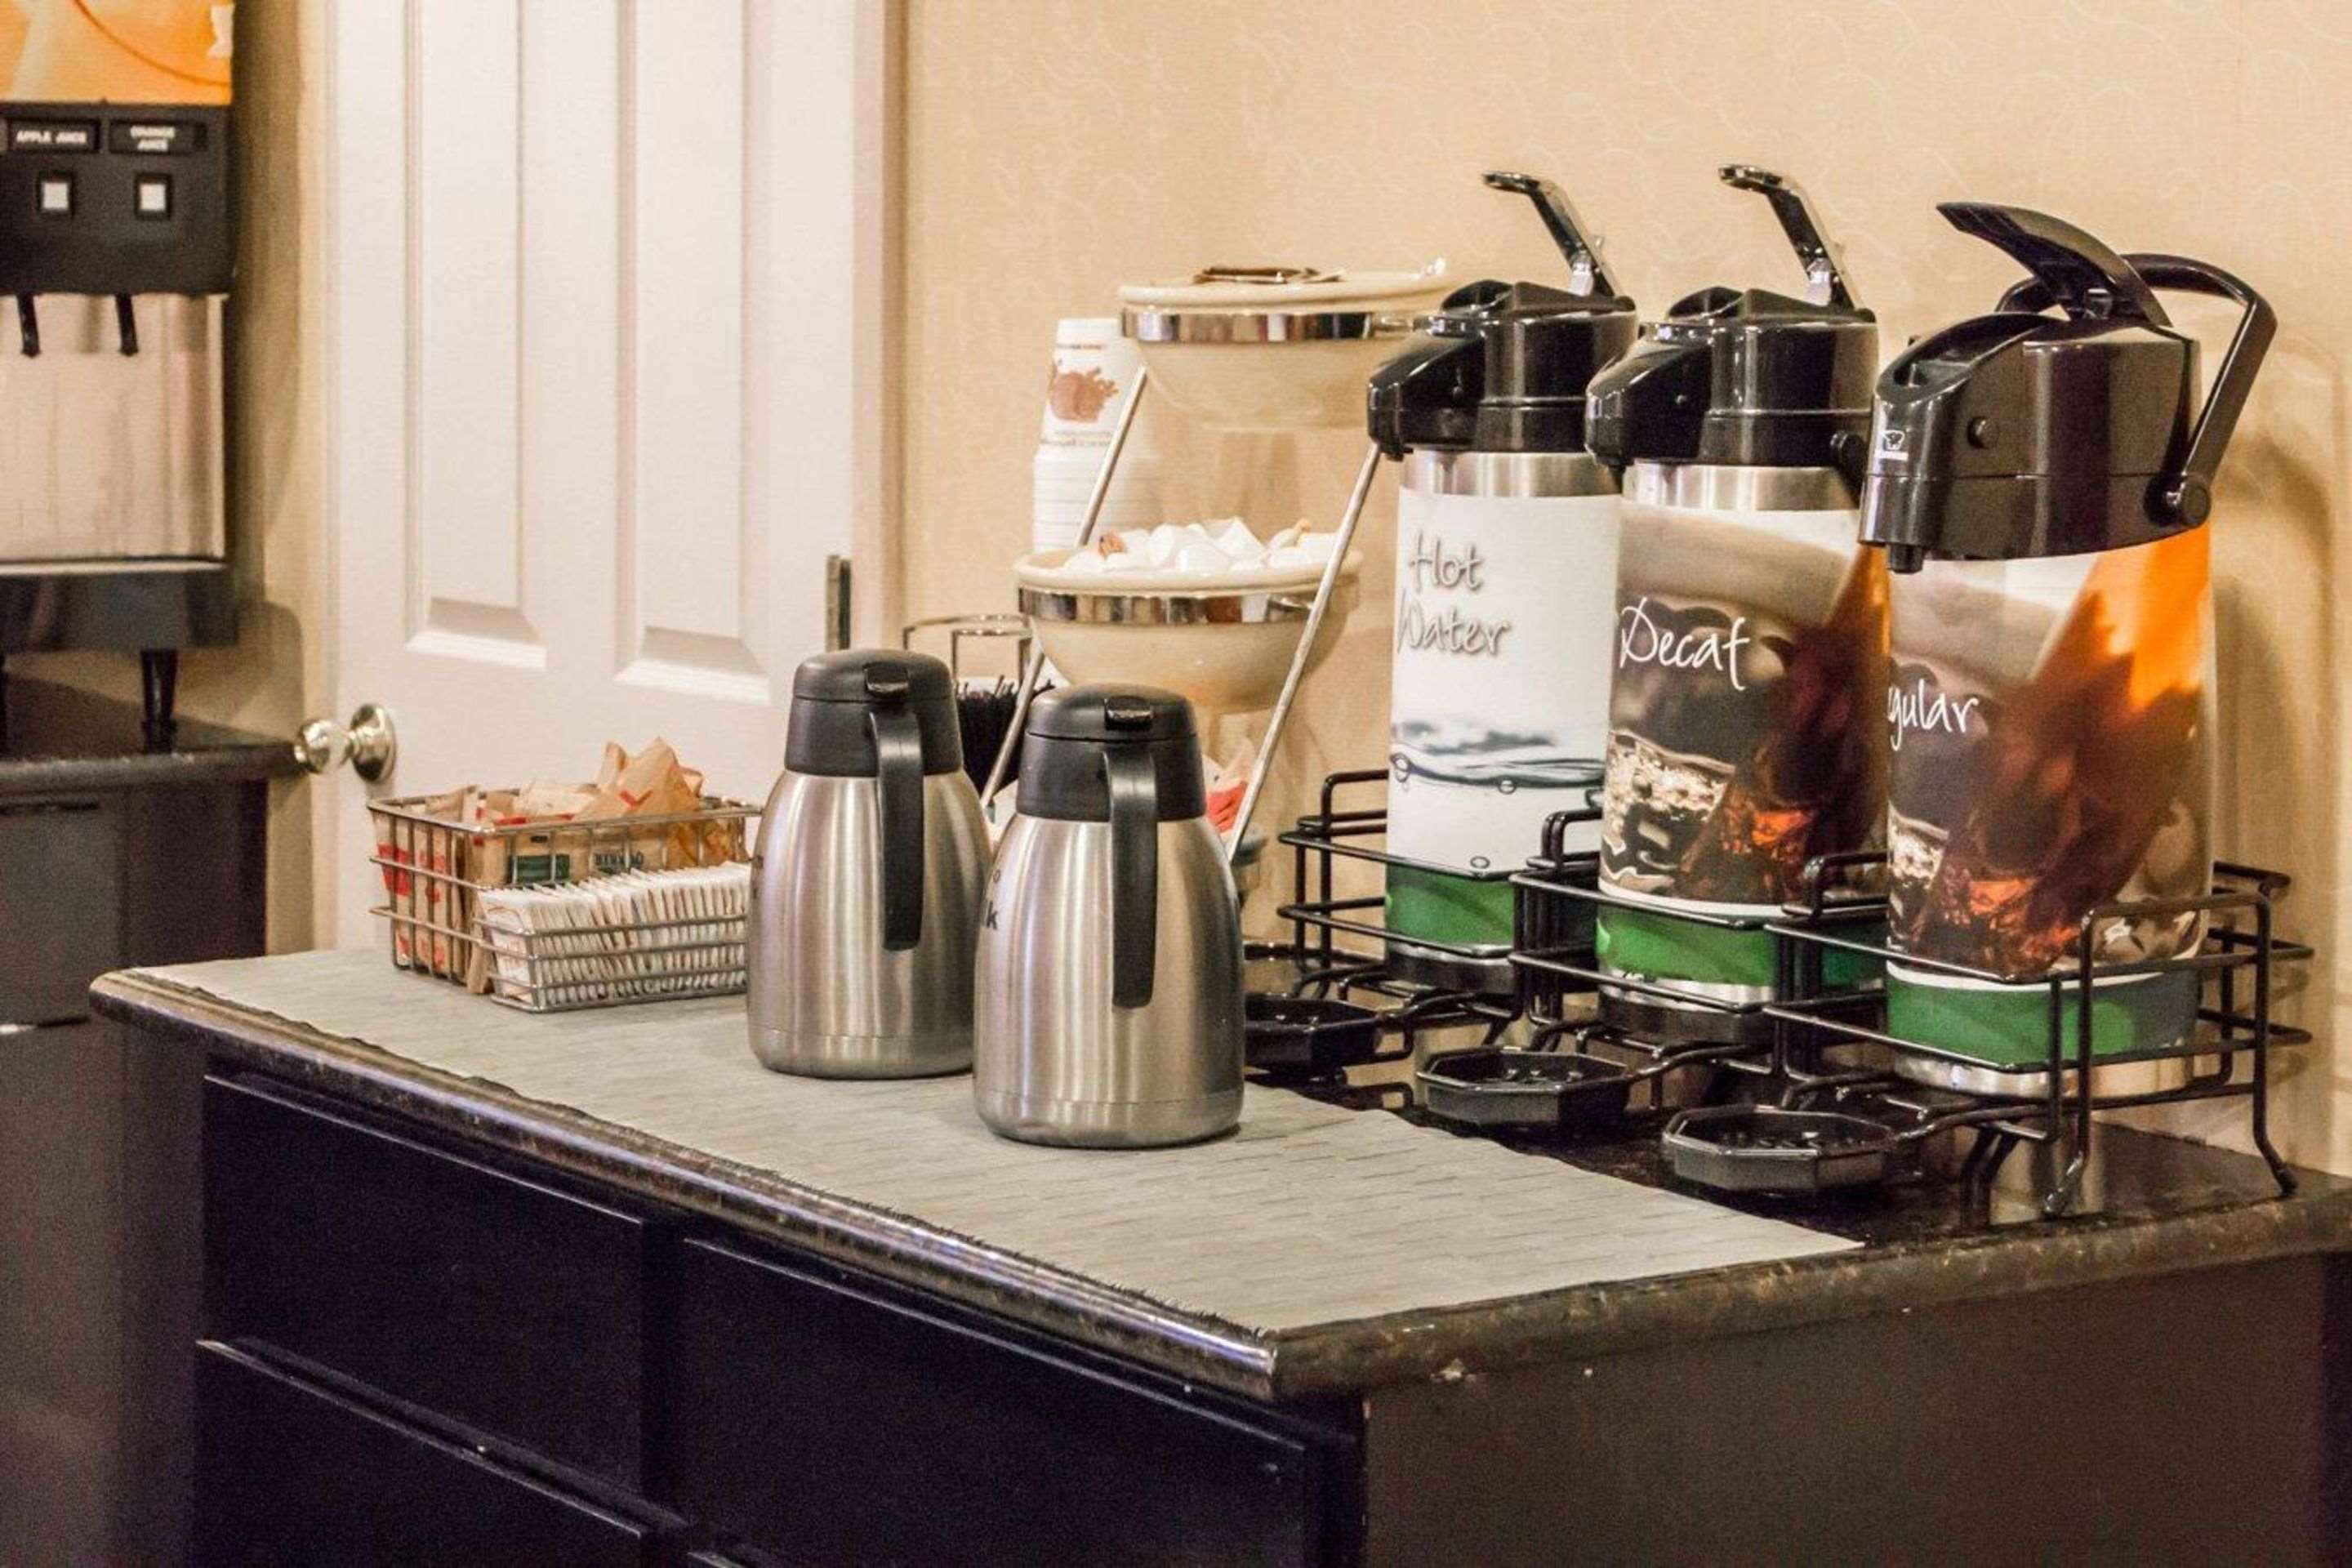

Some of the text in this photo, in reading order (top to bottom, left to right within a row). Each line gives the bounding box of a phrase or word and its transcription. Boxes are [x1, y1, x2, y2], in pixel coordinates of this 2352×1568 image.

[1409, 532, 1483, 591] Hot
[1396, 588, 1512, 657] Water
[1619, 597, 1750, 691] Decaf
[1887, 679, 1980, 751] gular
